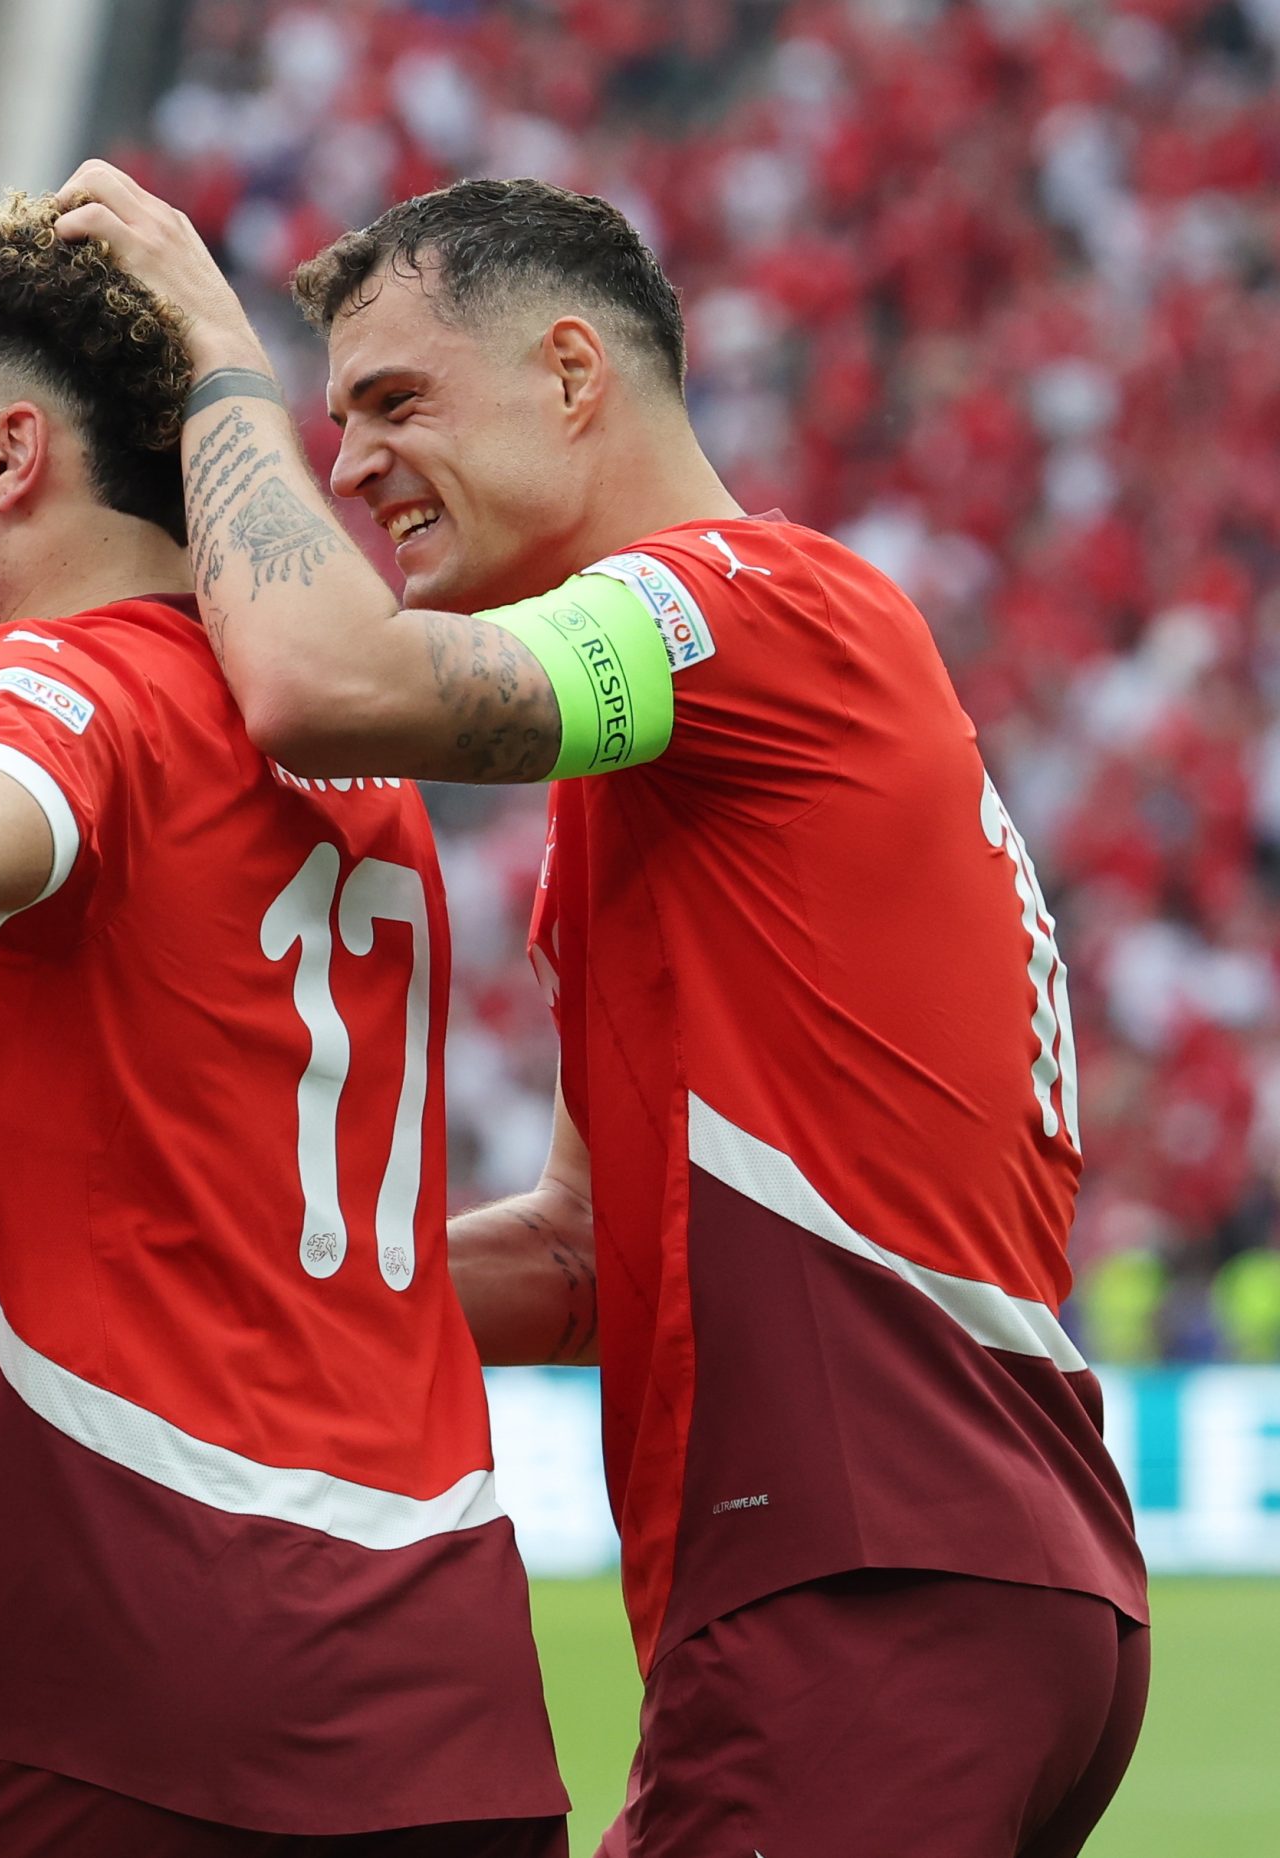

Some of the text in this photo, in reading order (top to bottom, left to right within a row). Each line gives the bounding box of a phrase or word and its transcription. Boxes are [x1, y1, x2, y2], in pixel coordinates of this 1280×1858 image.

[580, 638, 627, 764] RESPECT
[260, 841, 430, 1292] 17
[712, 1494, 769, 1515] ULTRAWEAVE
